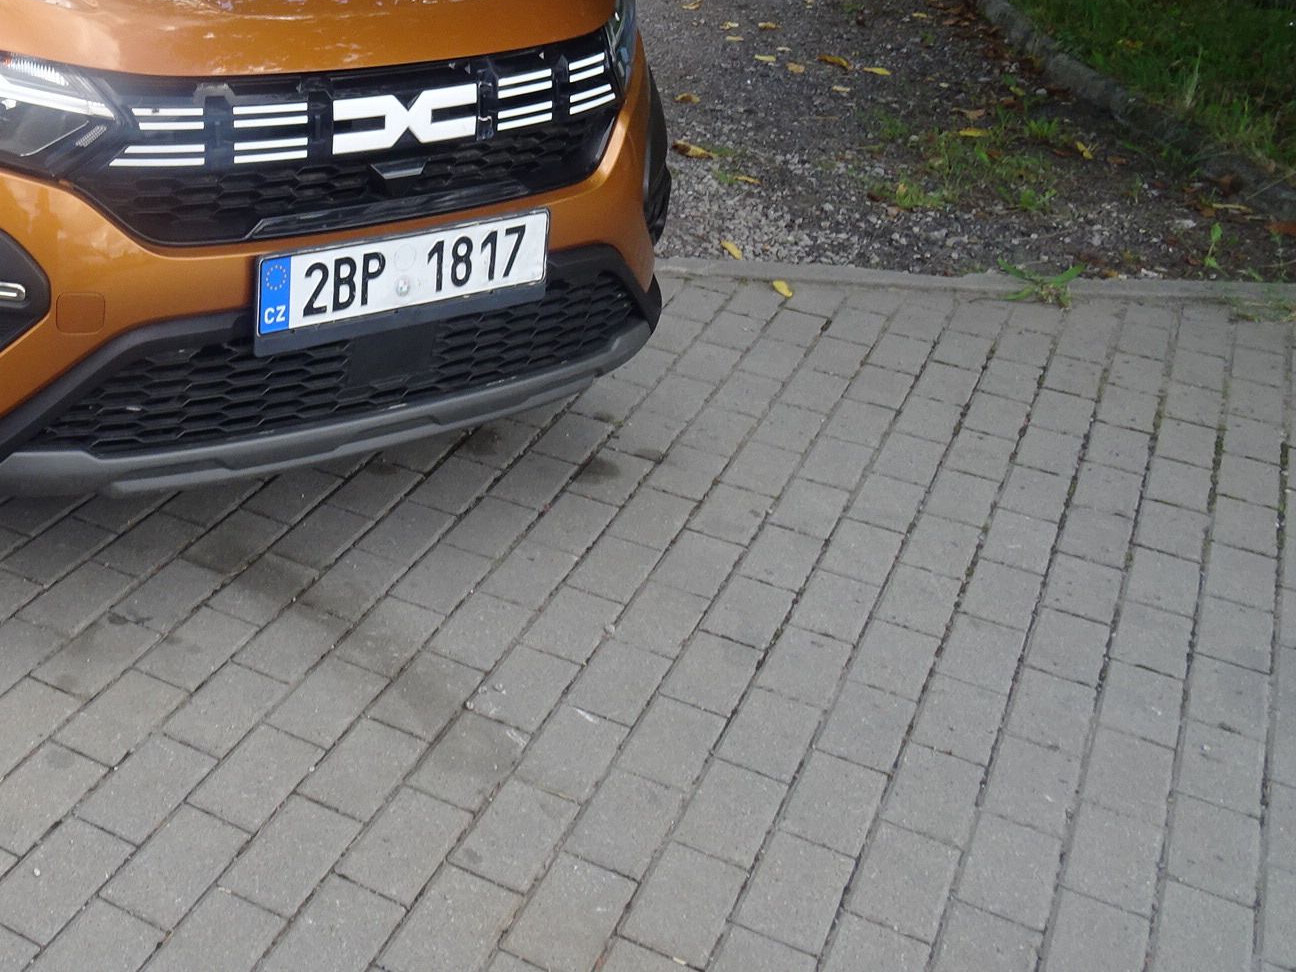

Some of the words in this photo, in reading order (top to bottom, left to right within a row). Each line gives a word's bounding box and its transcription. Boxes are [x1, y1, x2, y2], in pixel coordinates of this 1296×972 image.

[301, 250, 387, 318] 2BP
[426, 226, 527, 294] 1817
[264, 304, 286, 325] CZ
